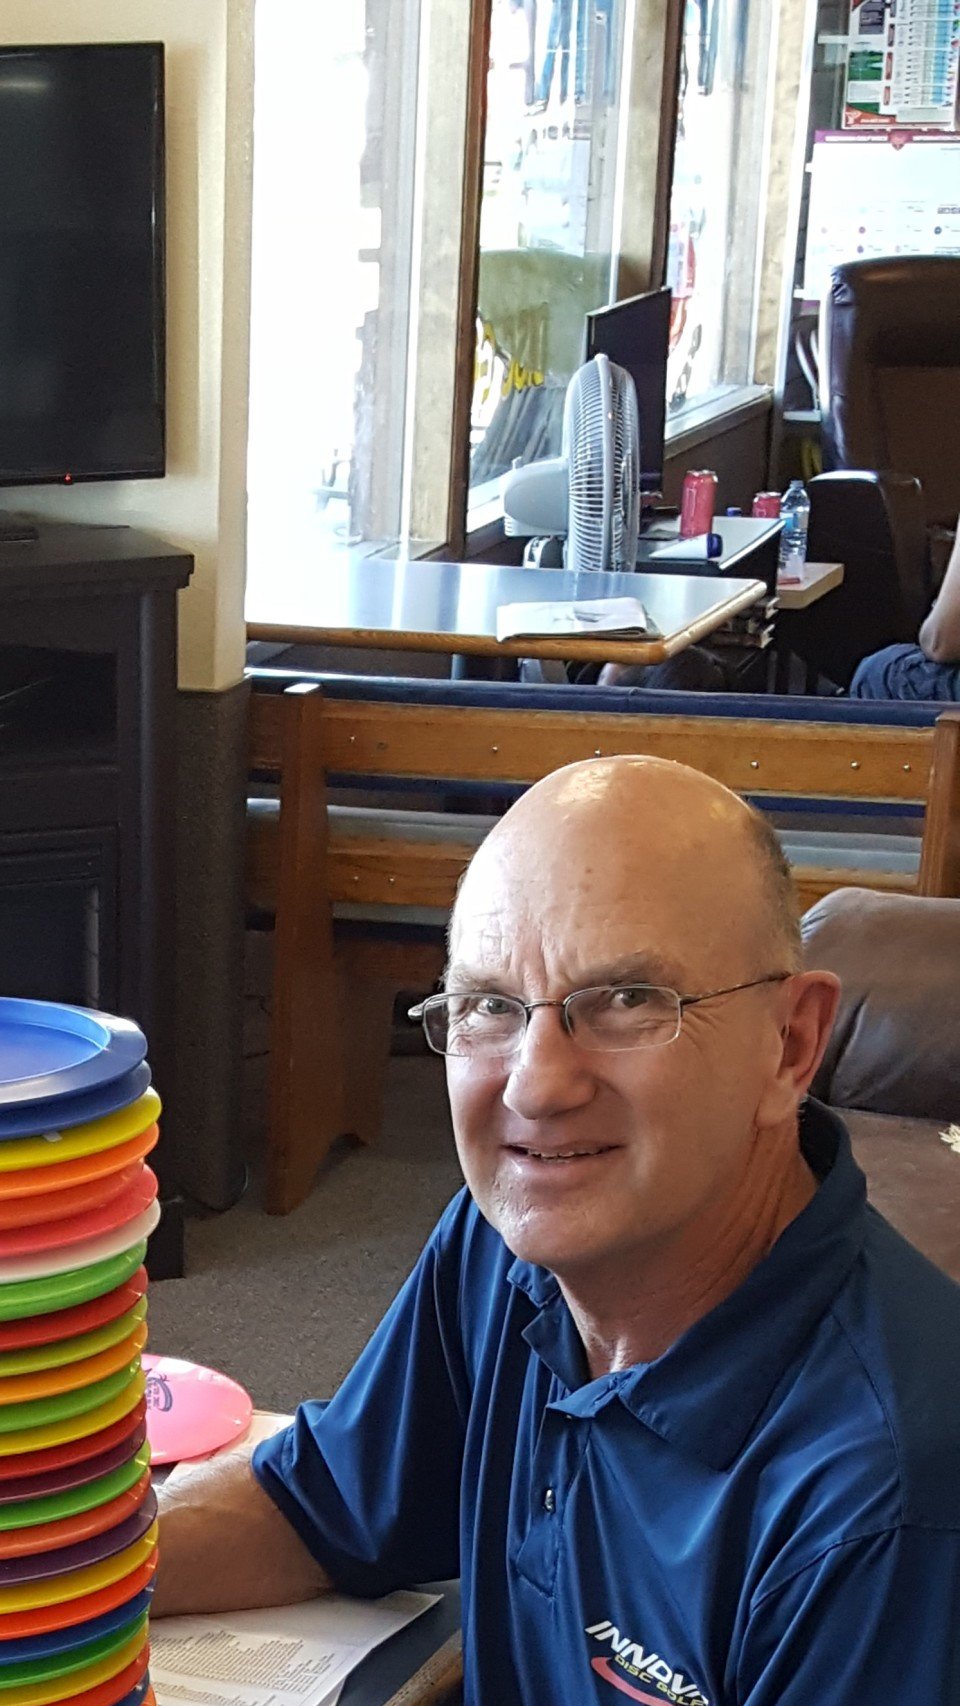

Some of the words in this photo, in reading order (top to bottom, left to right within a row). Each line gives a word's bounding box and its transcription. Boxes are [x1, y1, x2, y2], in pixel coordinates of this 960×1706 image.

[584, 1620, 711, 1706] INNOVA
[613, 1654, 654, 1684] DISC
[656, 1681, 705, 1706] GOLF
